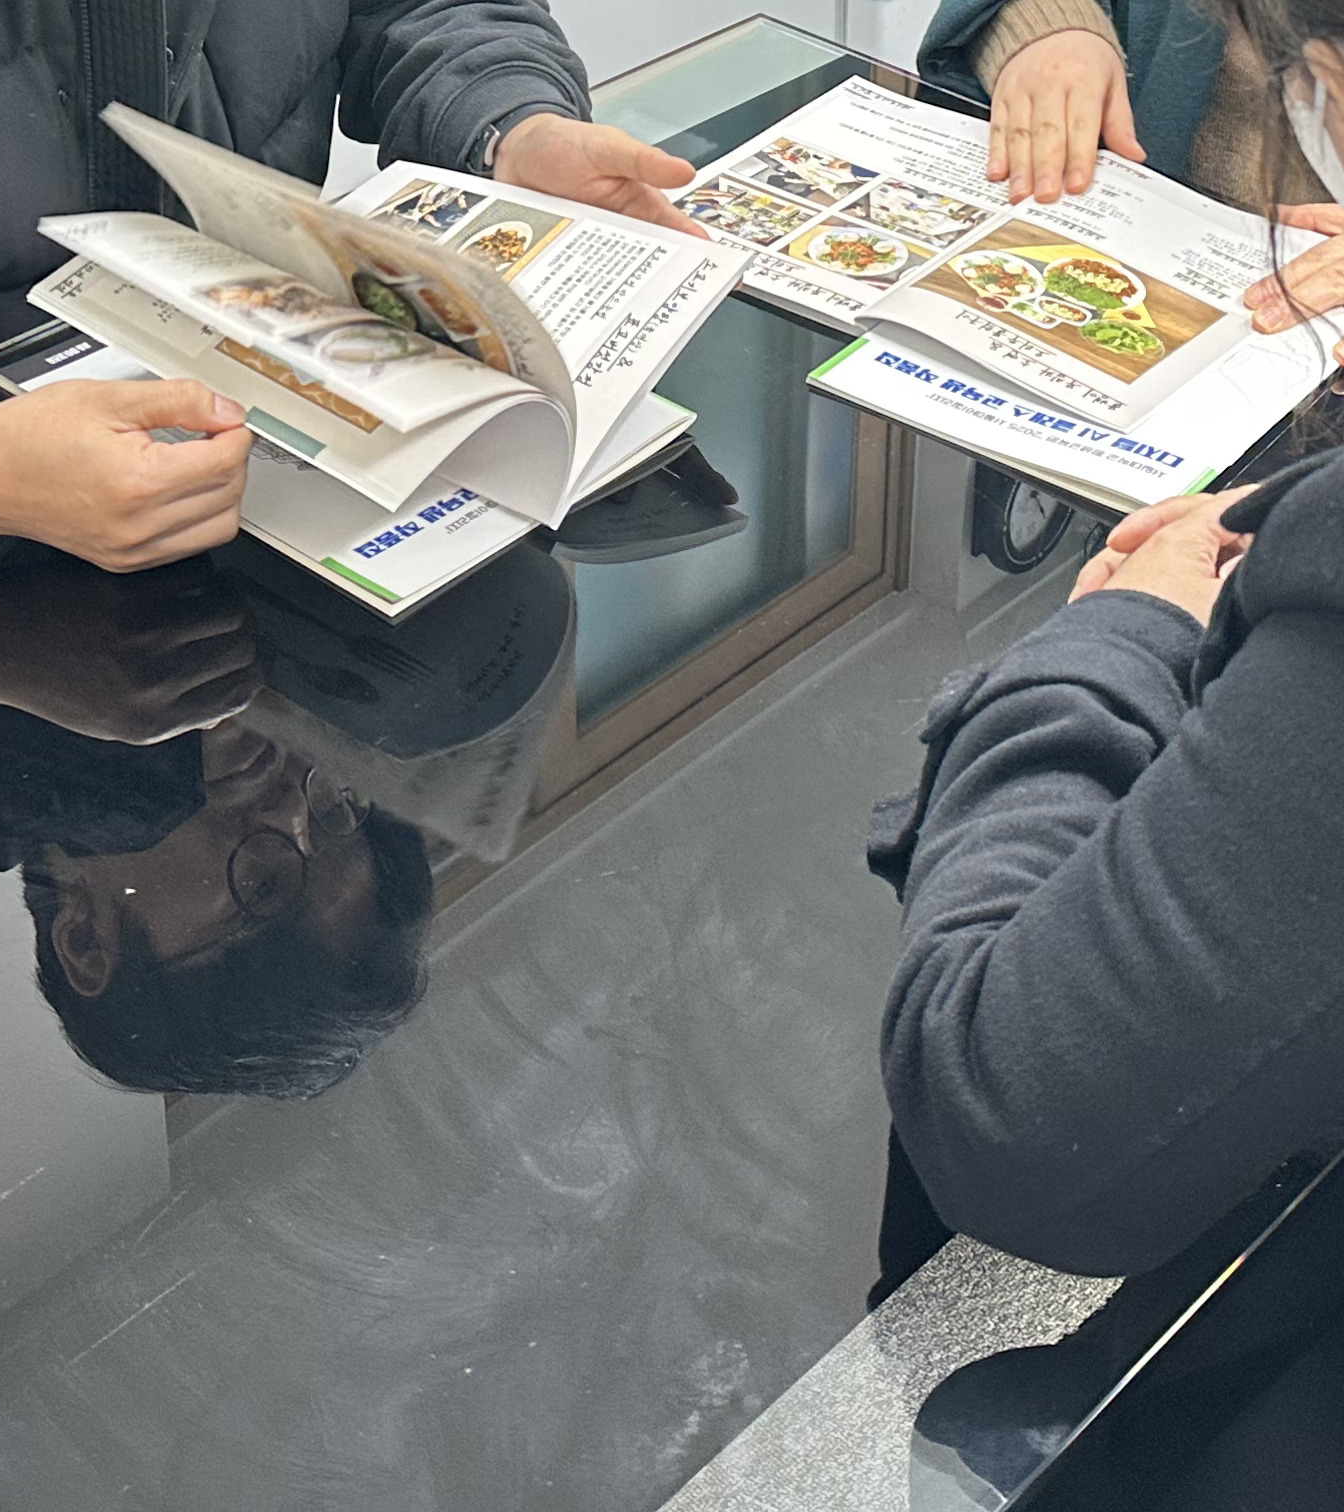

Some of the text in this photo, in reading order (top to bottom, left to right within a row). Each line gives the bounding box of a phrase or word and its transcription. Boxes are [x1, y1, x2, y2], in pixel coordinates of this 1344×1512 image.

[874, 351, 1185, 468] 디지털 AI 클래스 교육생 작품집
[1045, 436, 1106, 458] 평생교육원
[1106, 453, 1167, 478] 서일대학교
[352, 521, 425, 559] 작품집
